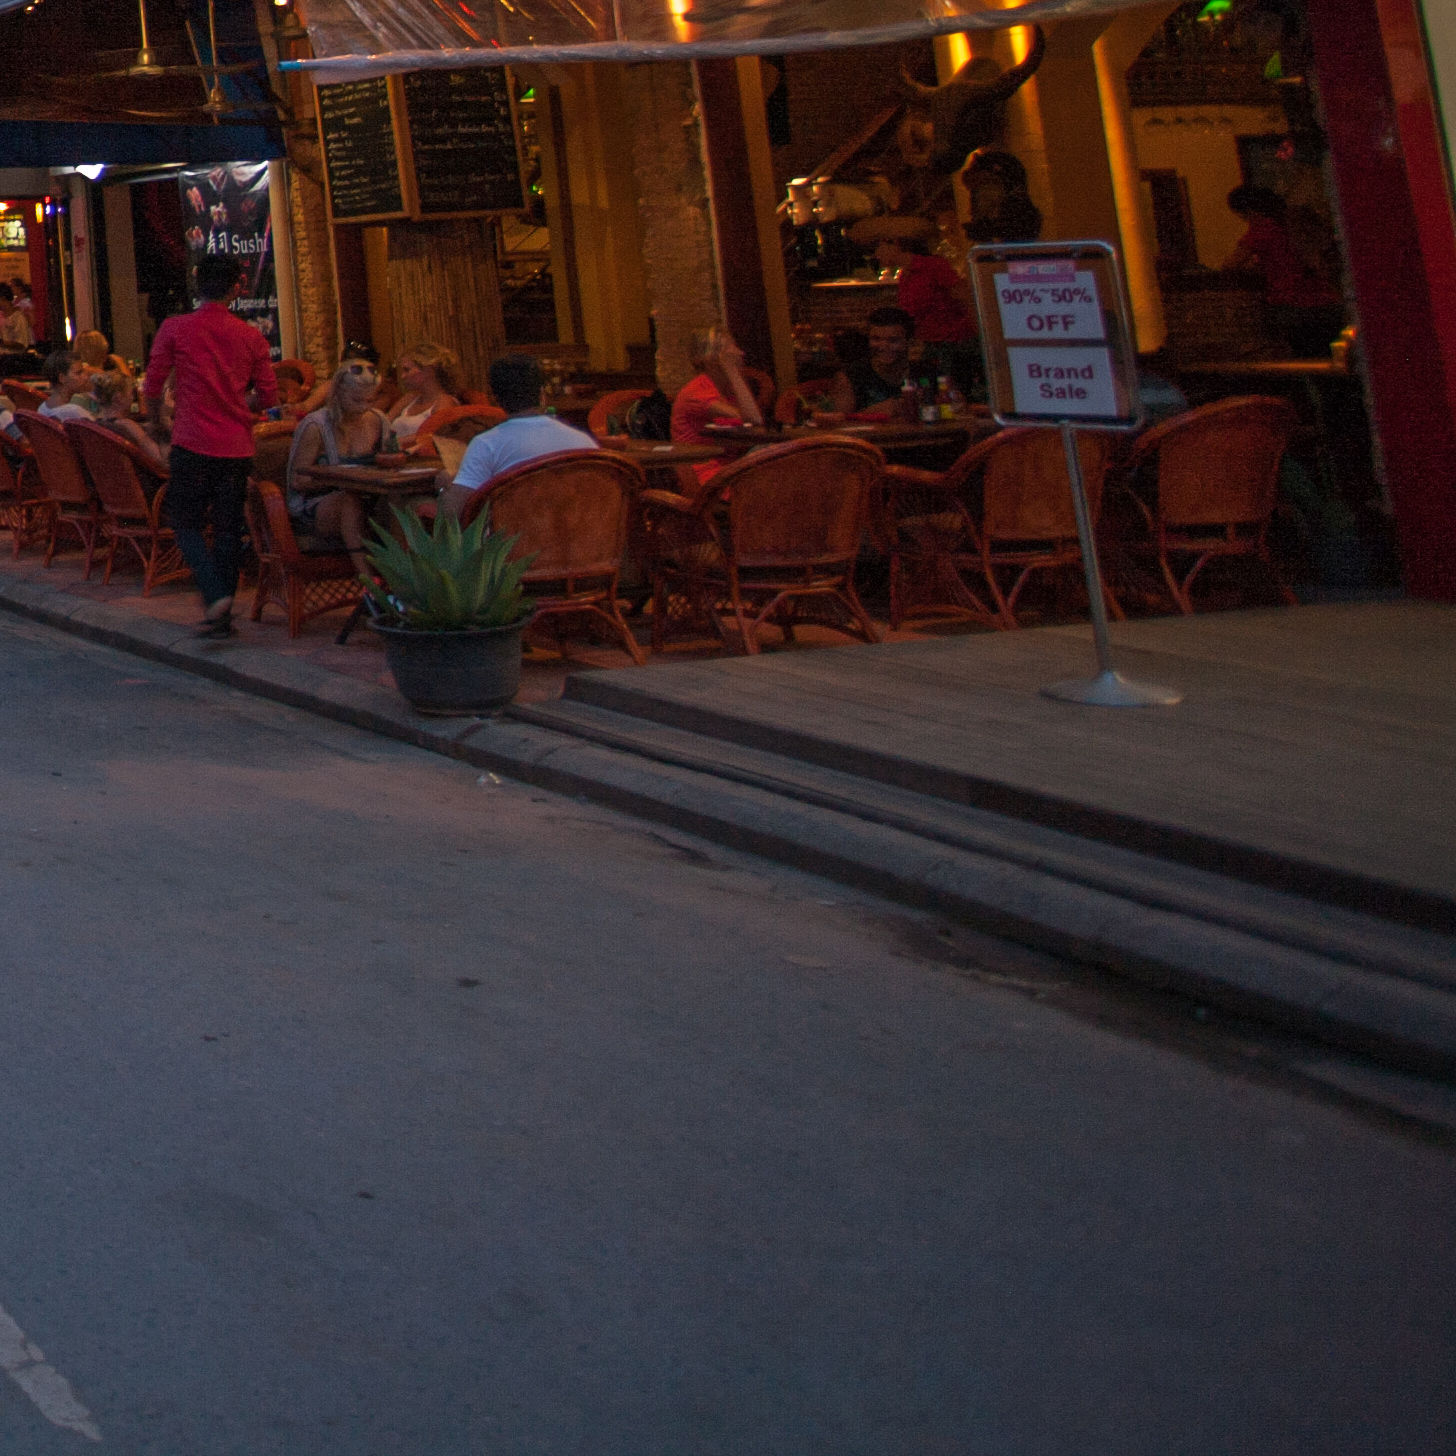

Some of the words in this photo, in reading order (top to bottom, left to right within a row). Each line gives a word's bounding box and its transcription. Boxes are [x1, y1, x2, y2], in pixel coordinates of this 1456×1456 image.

[231, 231, 269, 255] Sushi
[1026, 313, 1076, 332] OFF
[1027, 362, 1095, 380] Brand
[1039, 383, 1087, 401] Sale
